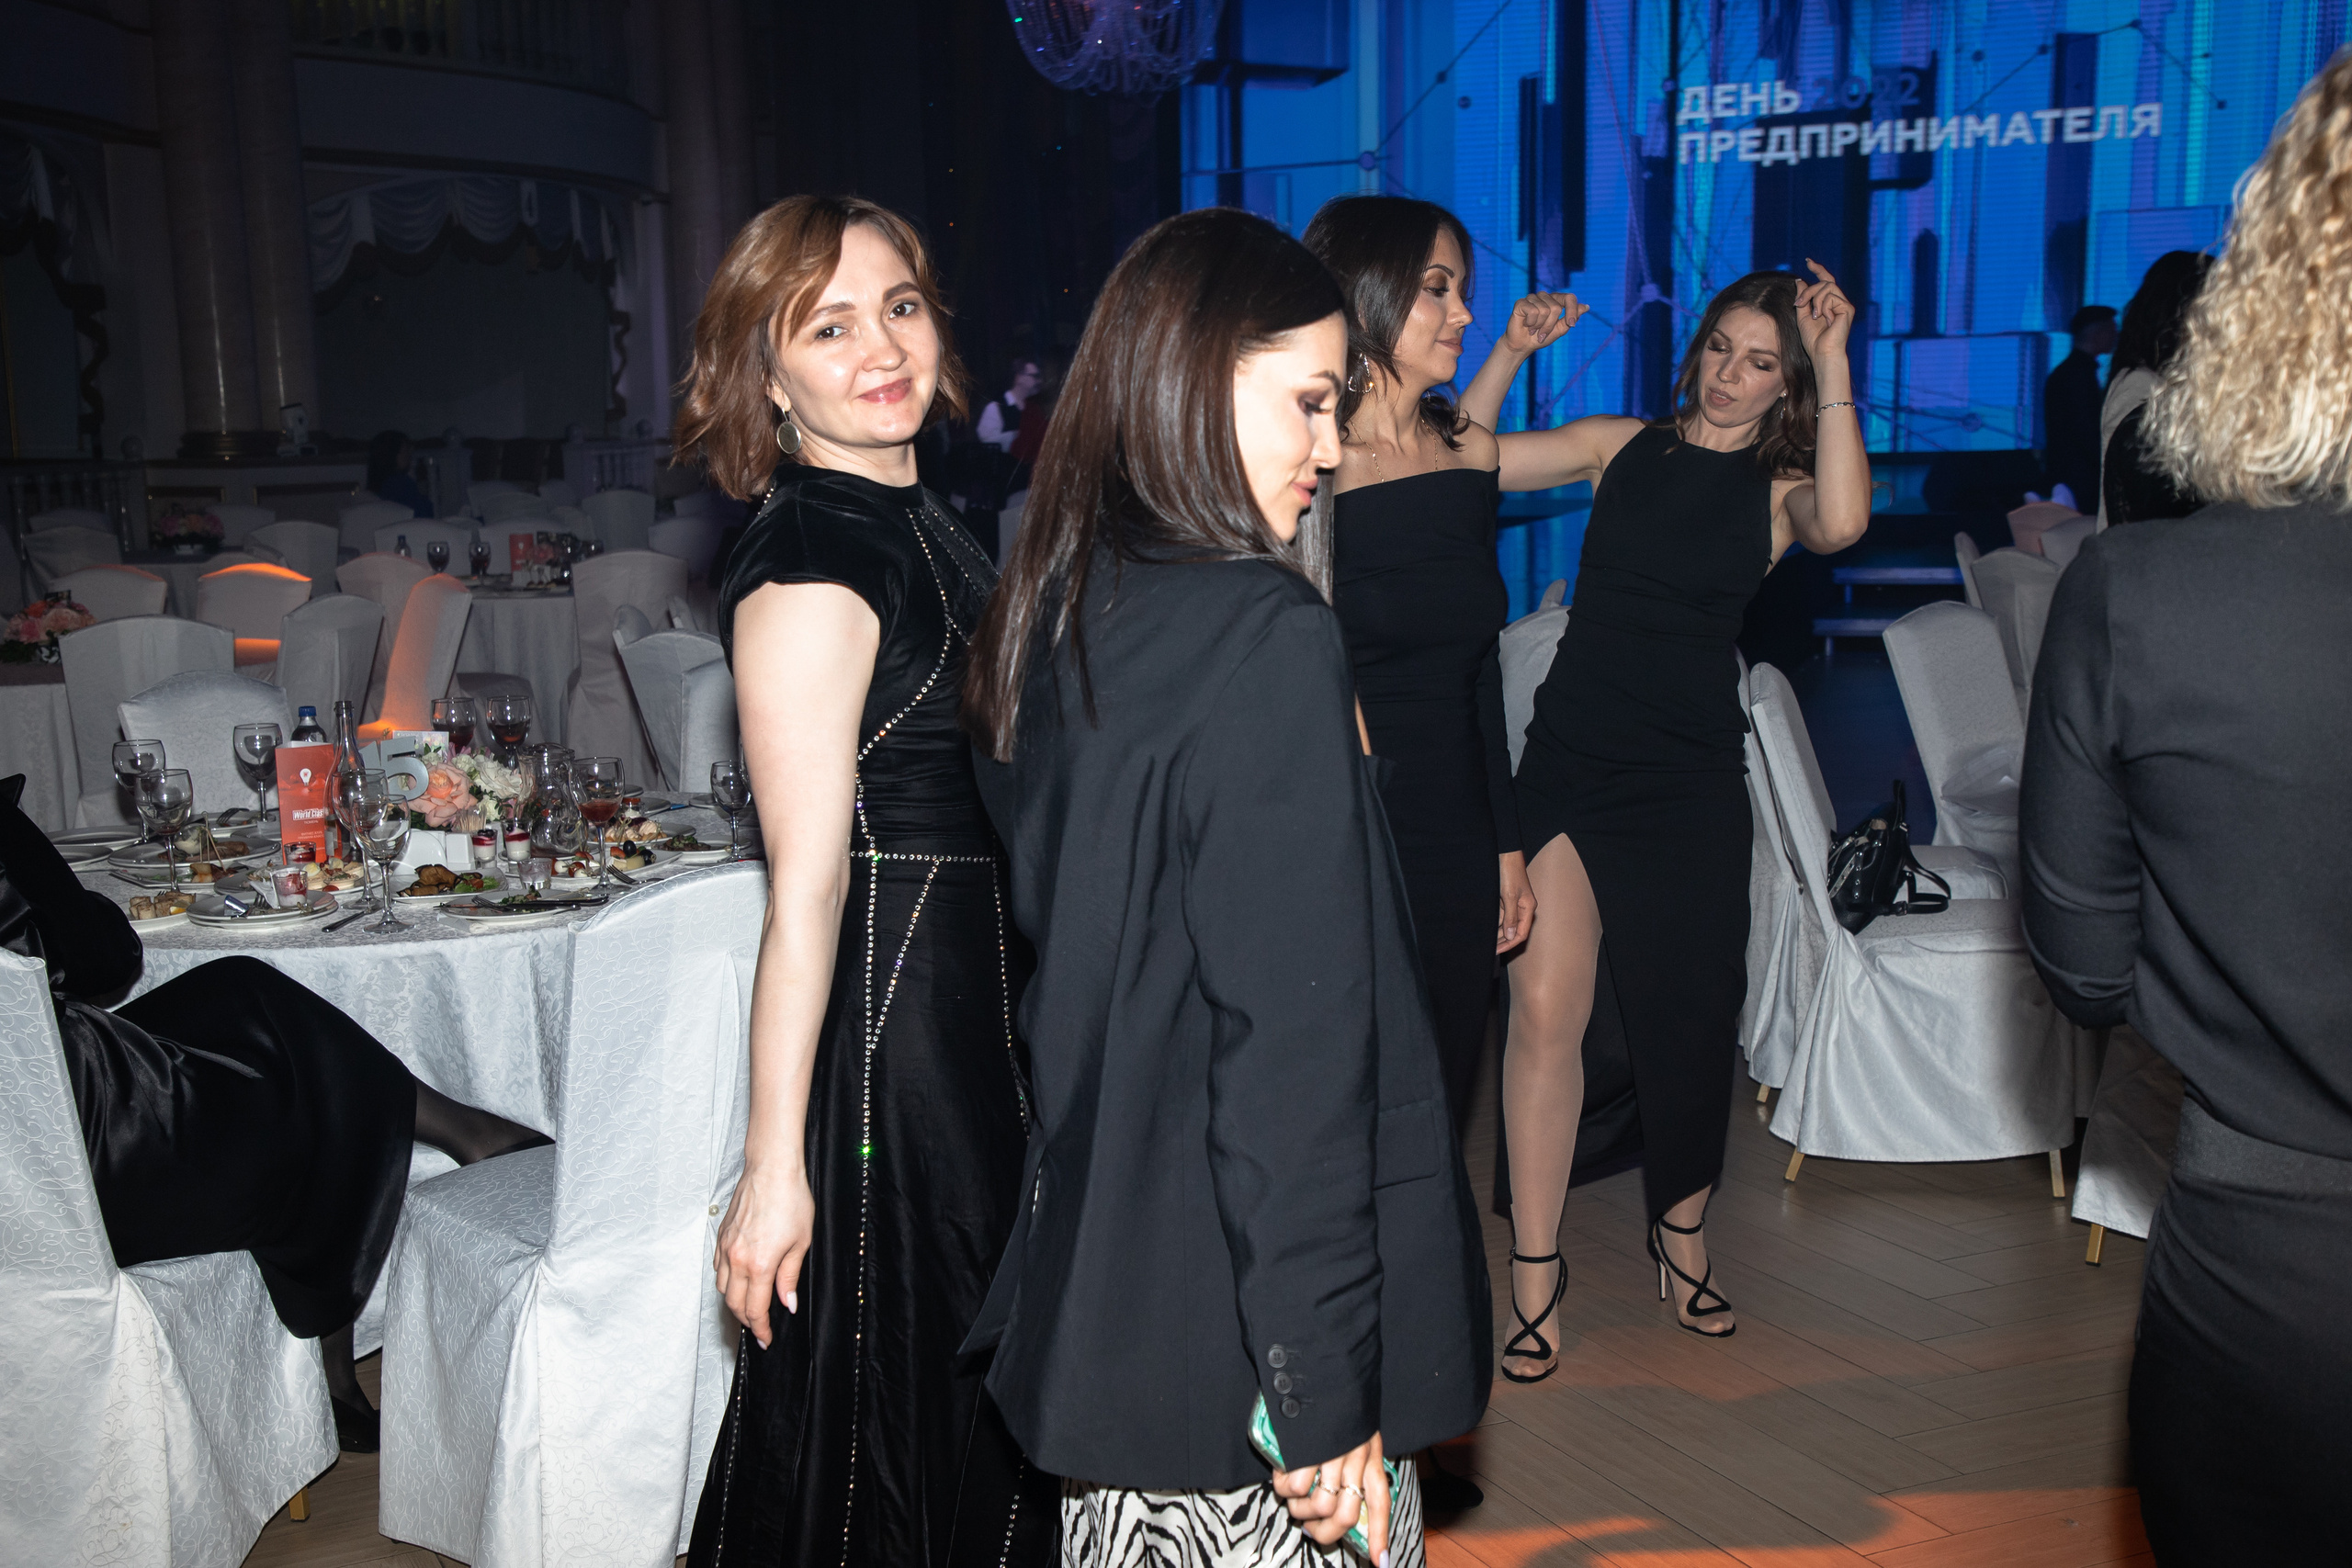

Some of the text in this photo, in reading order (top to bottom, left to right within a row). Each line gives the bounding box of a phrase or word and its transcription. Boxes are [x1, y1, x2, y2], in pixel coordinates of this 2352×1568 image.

[1676, 72, 1921, 126] ДЕНЬ 2022
[1678, 103, 2163, 167] ПРЕДПРИНИМАТЕЛЯ
[358, 736, 429, 801] 15
[294, 808, 326, 819] World Clas
